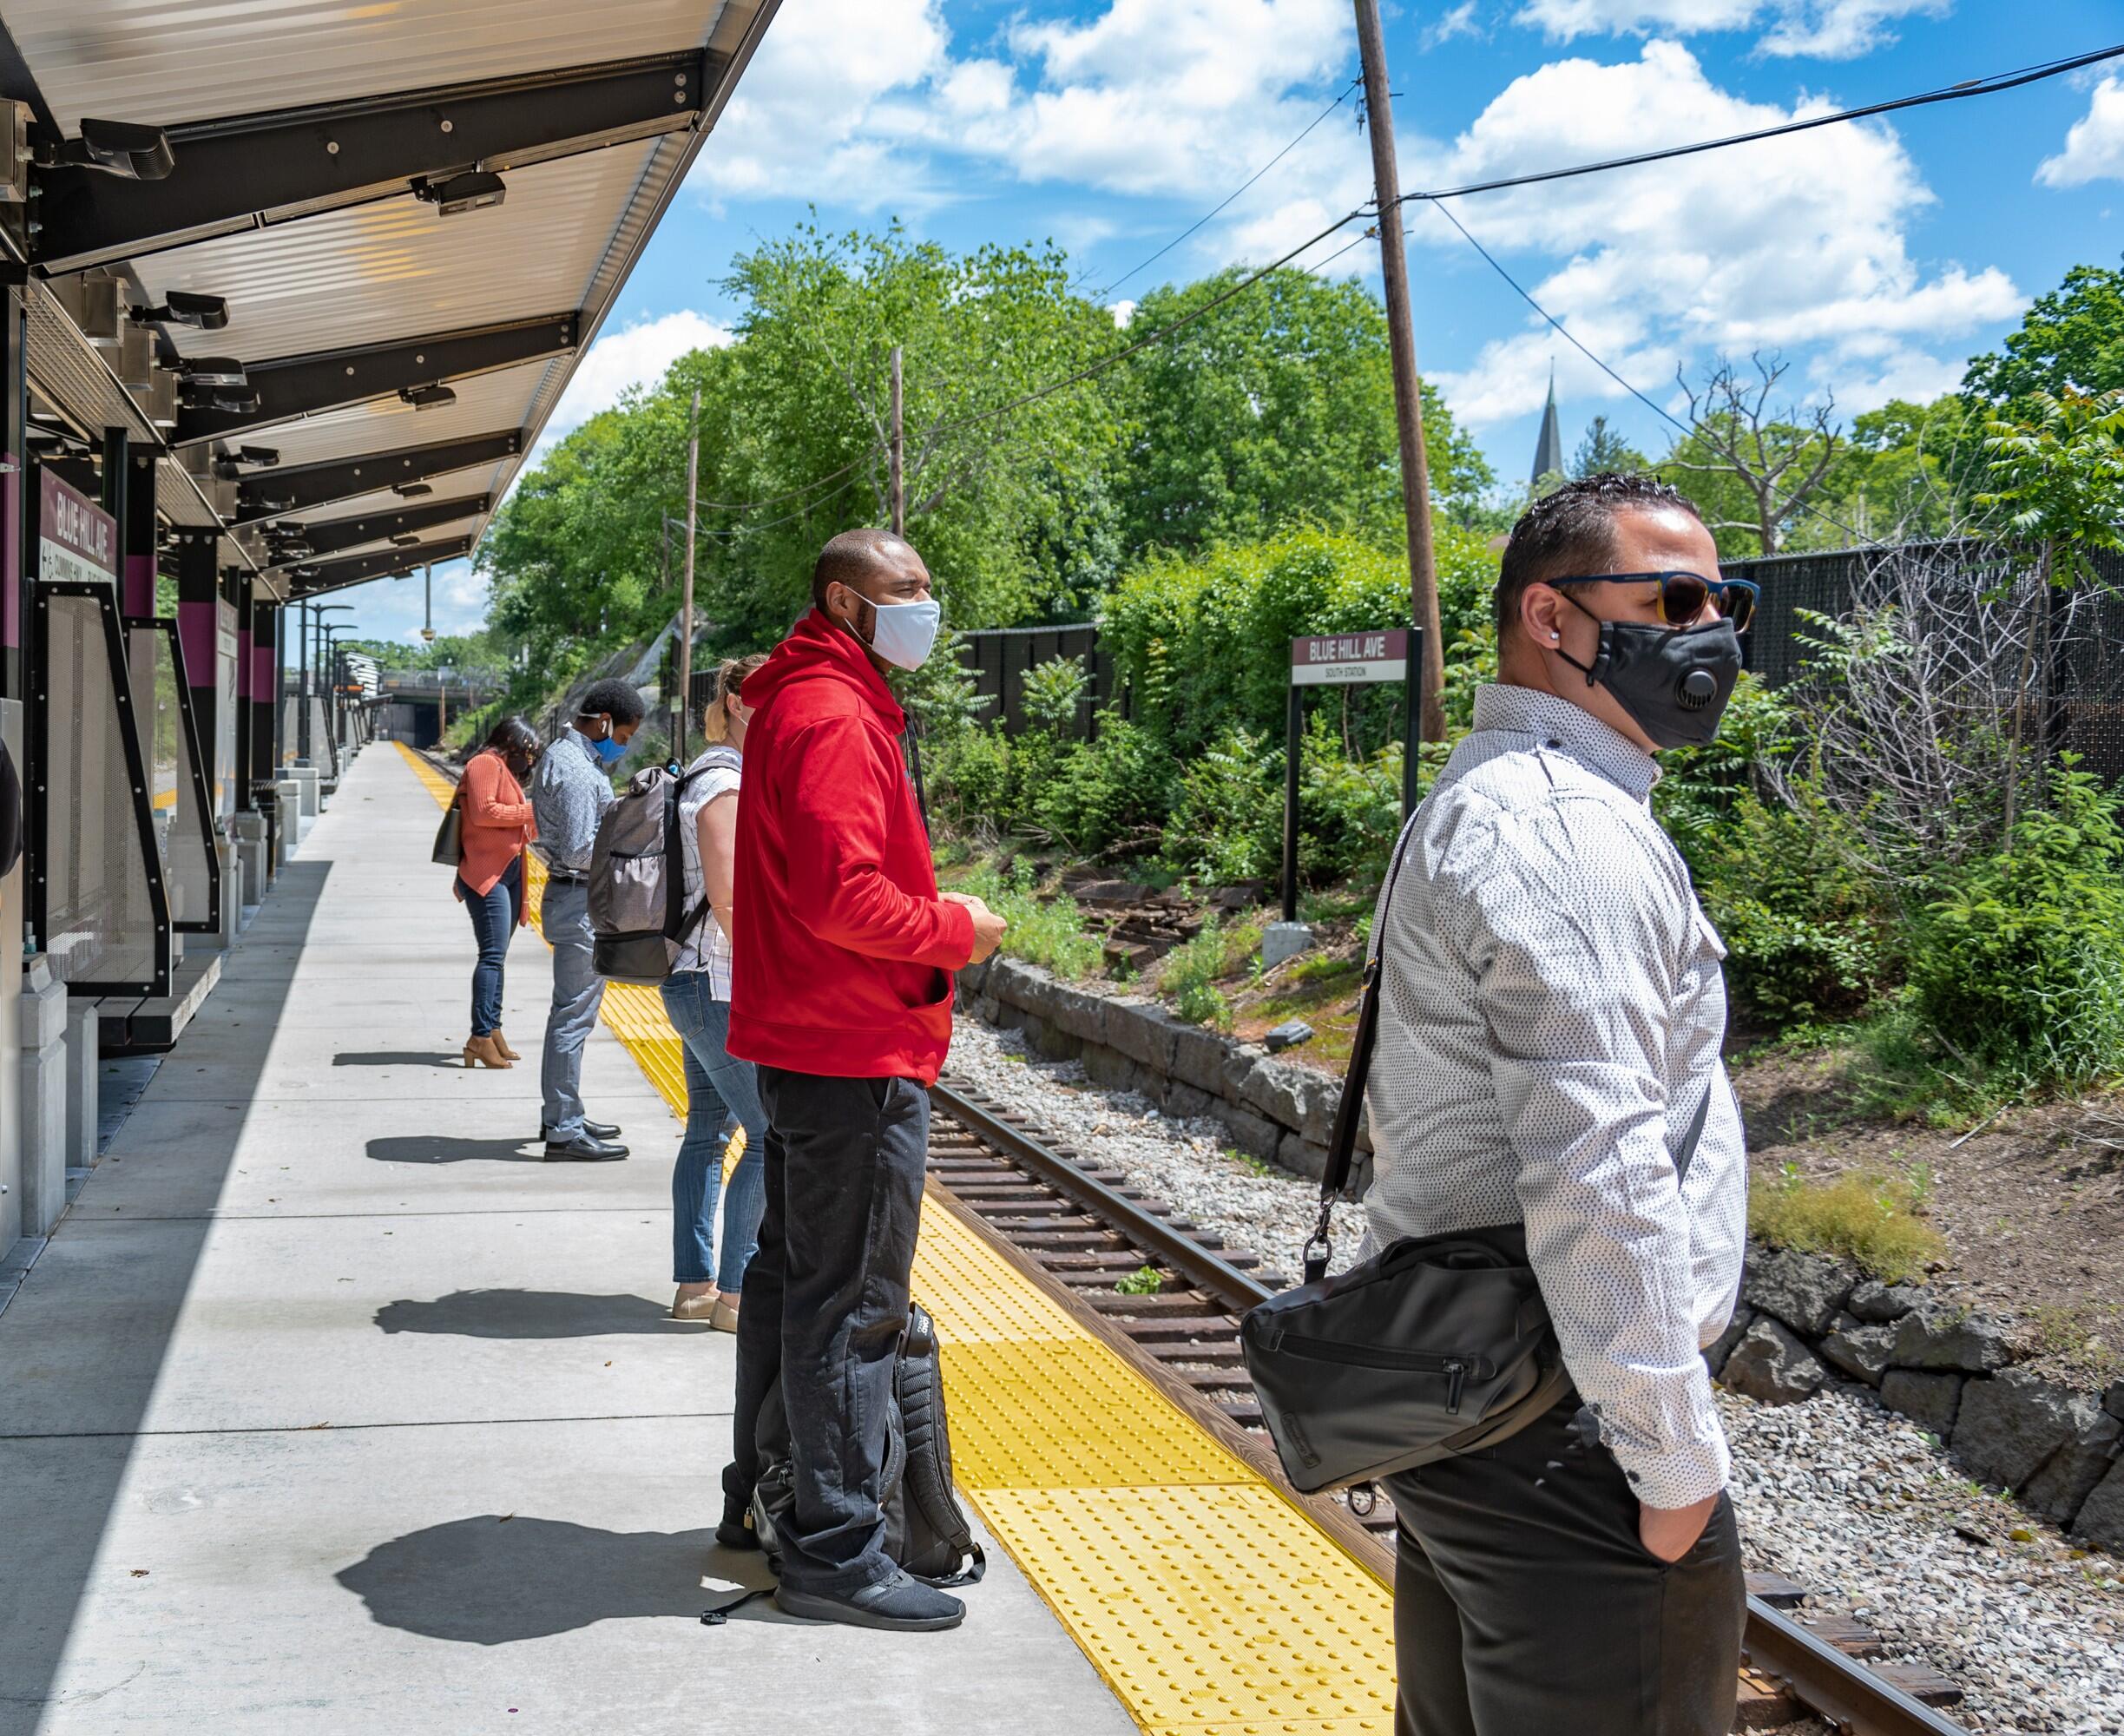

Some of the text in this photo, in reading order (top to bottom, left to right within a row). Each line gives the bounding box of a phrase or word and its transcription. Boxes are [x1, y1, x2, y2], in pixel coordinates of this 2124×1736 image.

[56, 491, 108, 563] BLUE HILL AVE
[1310, 635, 1385, 661] BLUE HILL AVE
[1325, 666, 1366, 678] SOUTH STATION
